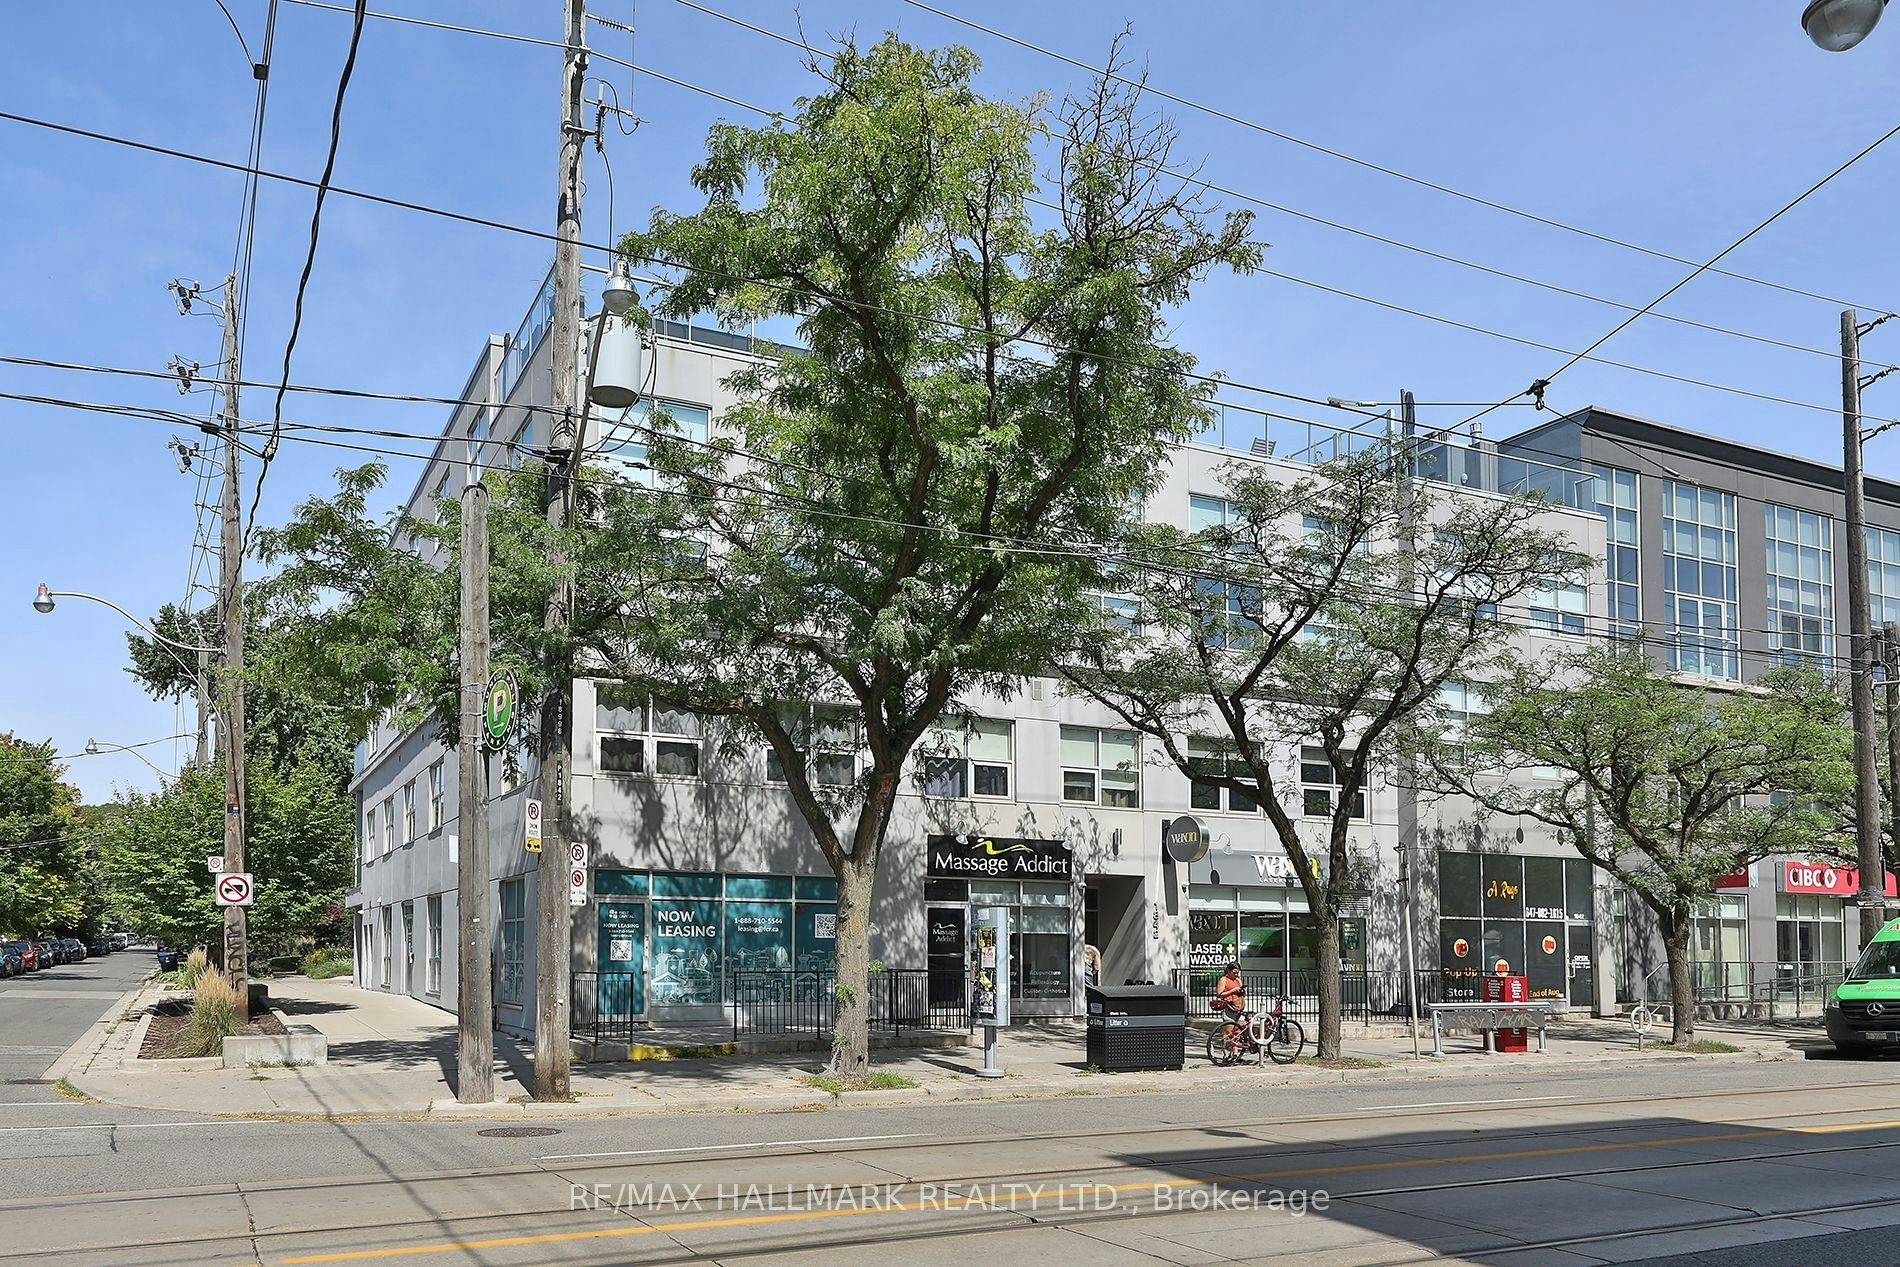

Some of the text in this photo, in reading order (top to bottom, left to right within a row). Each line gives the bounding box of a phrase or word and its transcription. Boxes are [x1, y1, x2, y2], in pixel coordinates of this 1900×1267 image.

[935, 852, 1068, 876] Massage Addict
[1789, 868, 1822, 887] CIBC
[657, 911, 695, 923] NOW
[734, 917, 783, 925] 1-888-710-5544
[657, 925, 716, 937] LEASING
[737, 925, 779, 934] leasing@fcr.ca
[932, 929, 958, 937] Massage
[1189, 943, 1223, 954] LASER
[1448, 987, 1474, 997] Store
